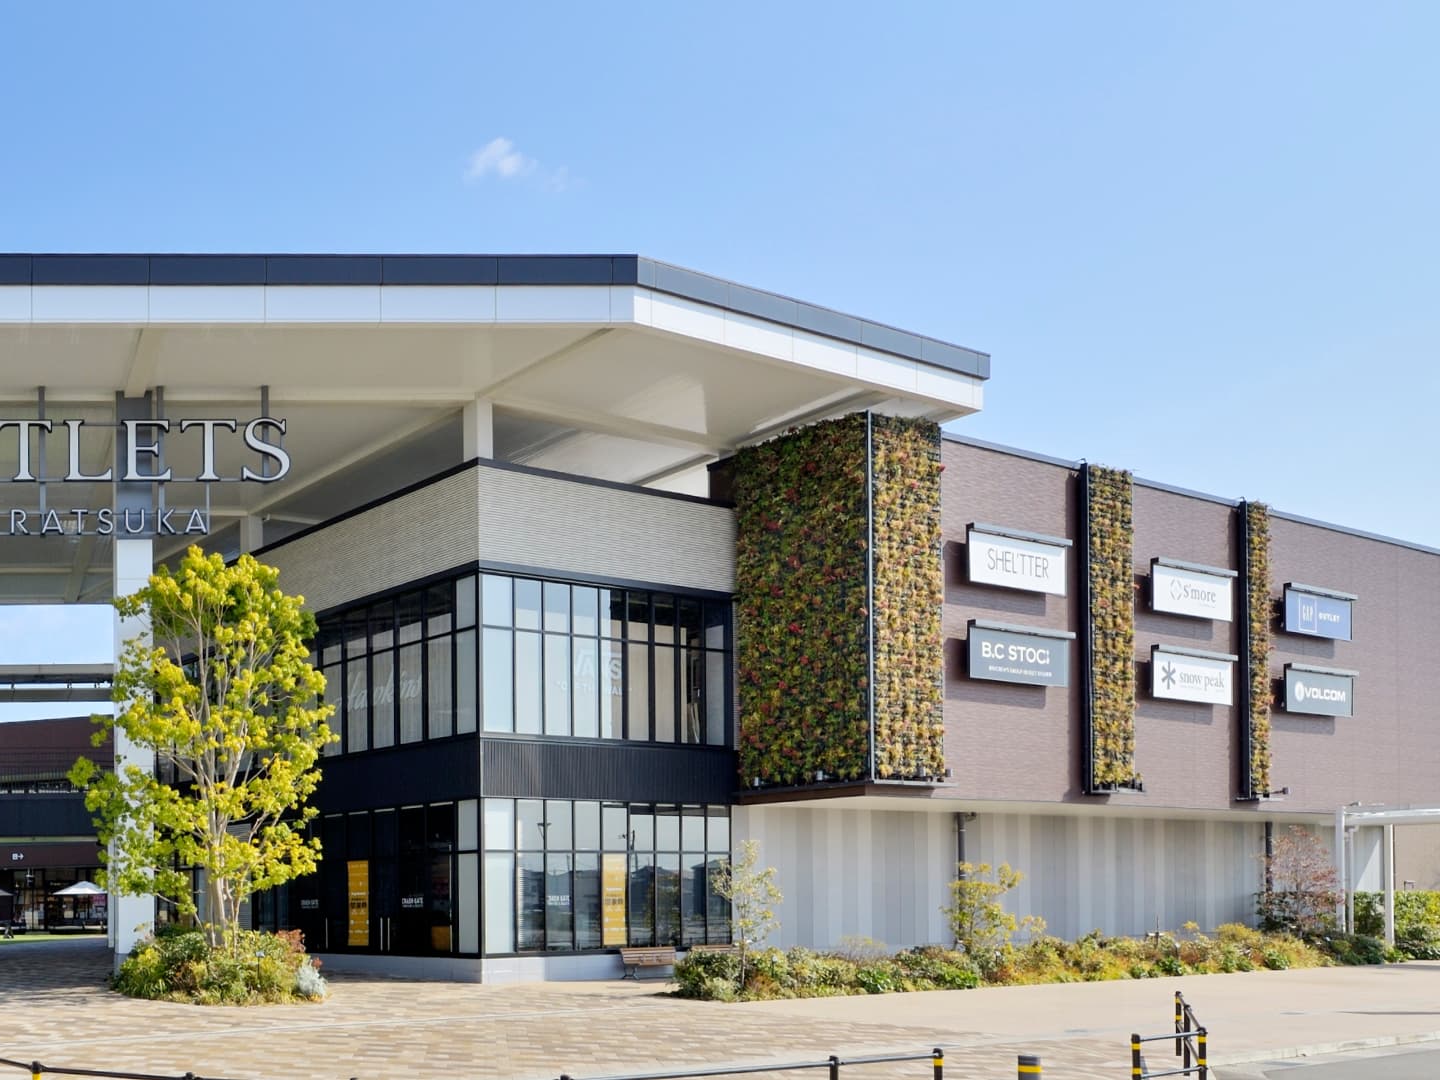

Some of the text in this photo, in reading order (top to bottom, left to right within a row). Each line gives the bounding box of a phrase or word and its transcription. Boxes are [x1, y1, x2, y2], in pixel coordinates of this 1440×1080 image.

[1183, 582, 1217, 604] S'more
[981, 640, 1006, 660] B.C
[1179, 671, 1225, 692] snow peak
[1304, 686, 1346, 704] VOLCOM
